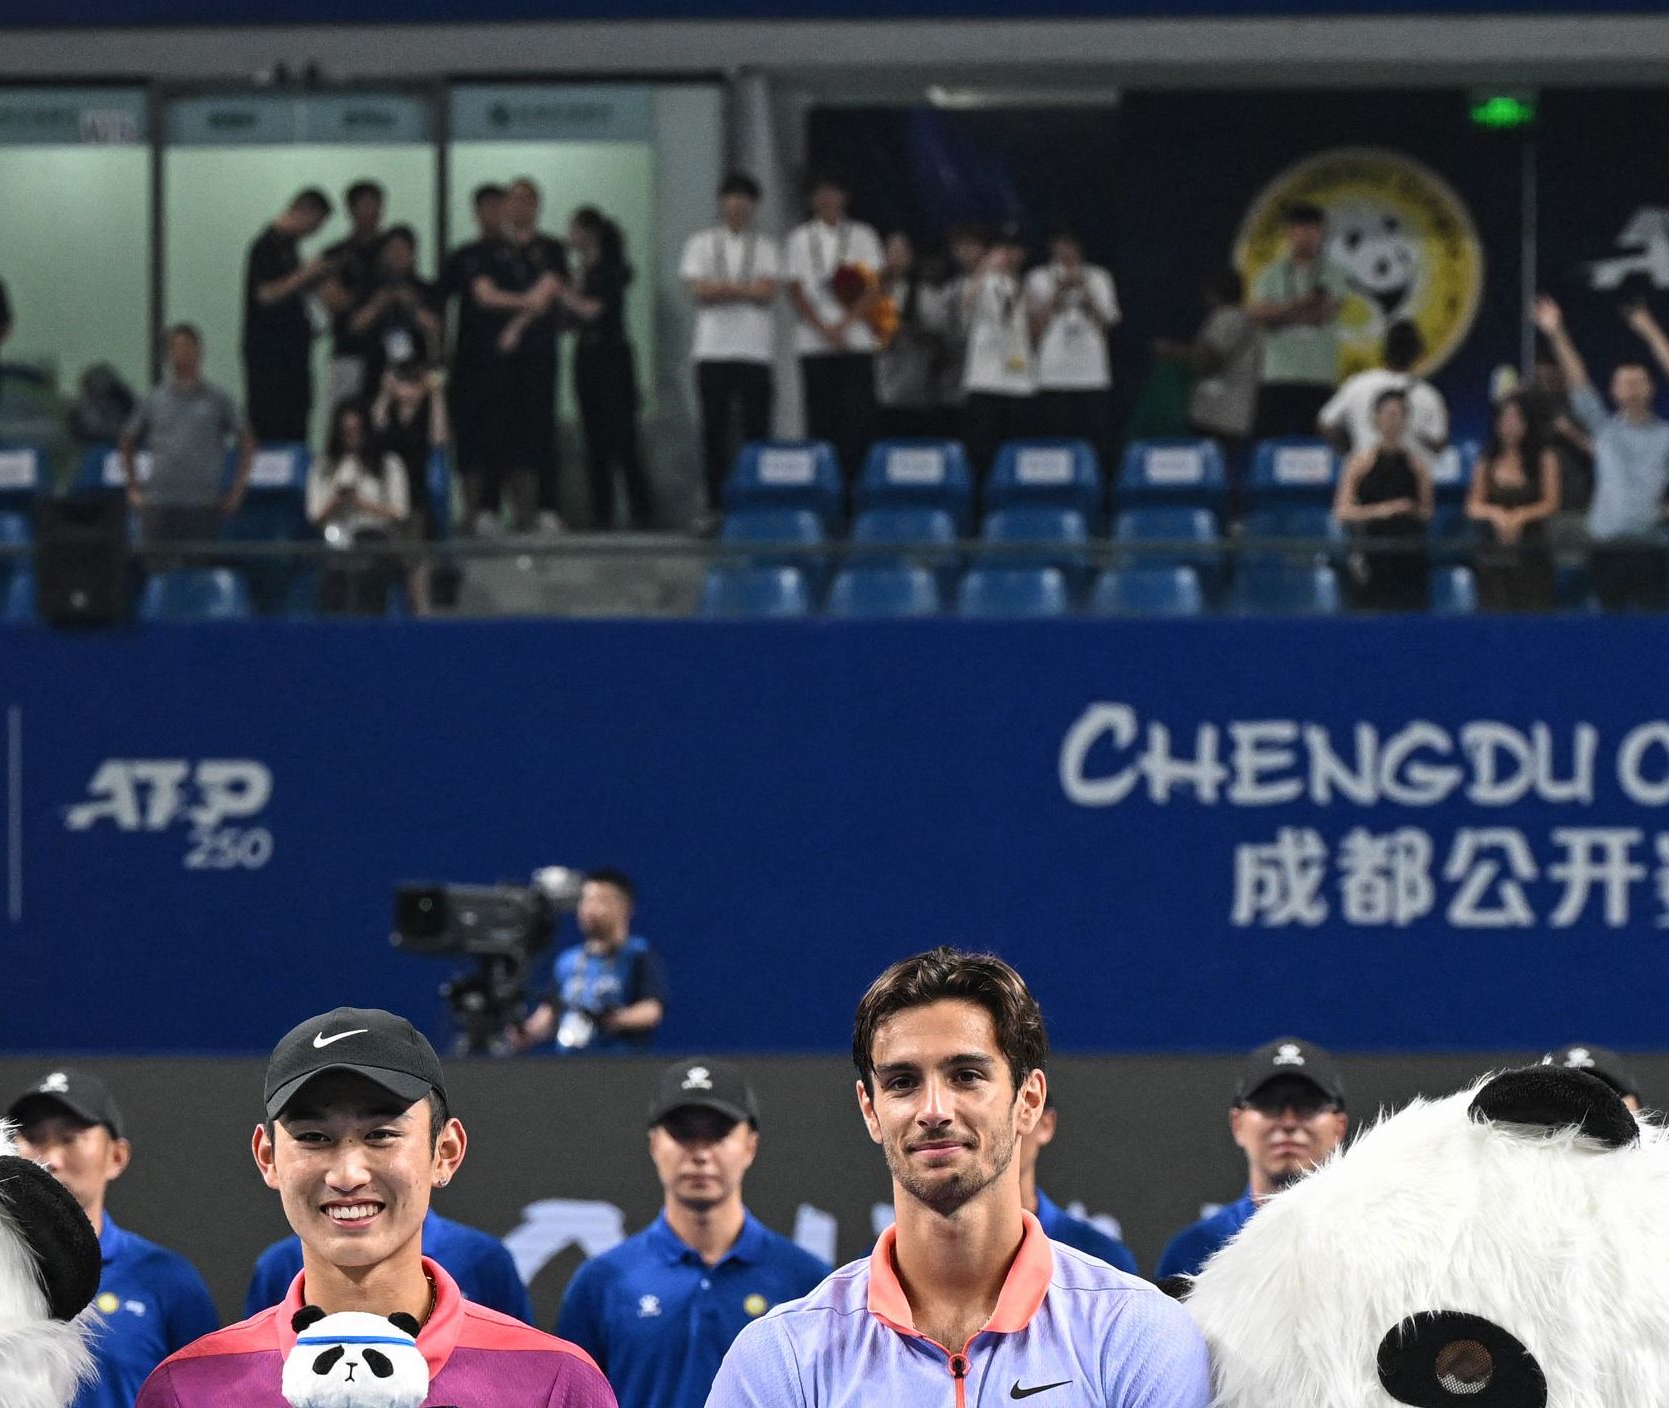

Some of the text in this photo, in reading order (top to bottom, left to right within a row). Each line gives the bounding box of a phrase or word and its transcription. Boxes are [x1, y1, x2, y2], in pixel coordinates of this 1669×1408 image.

[1059, 703, 1598, 807] CHENGDU
[64, 758, 274, 832] ATP
[184, 826, 275, 869] 250
